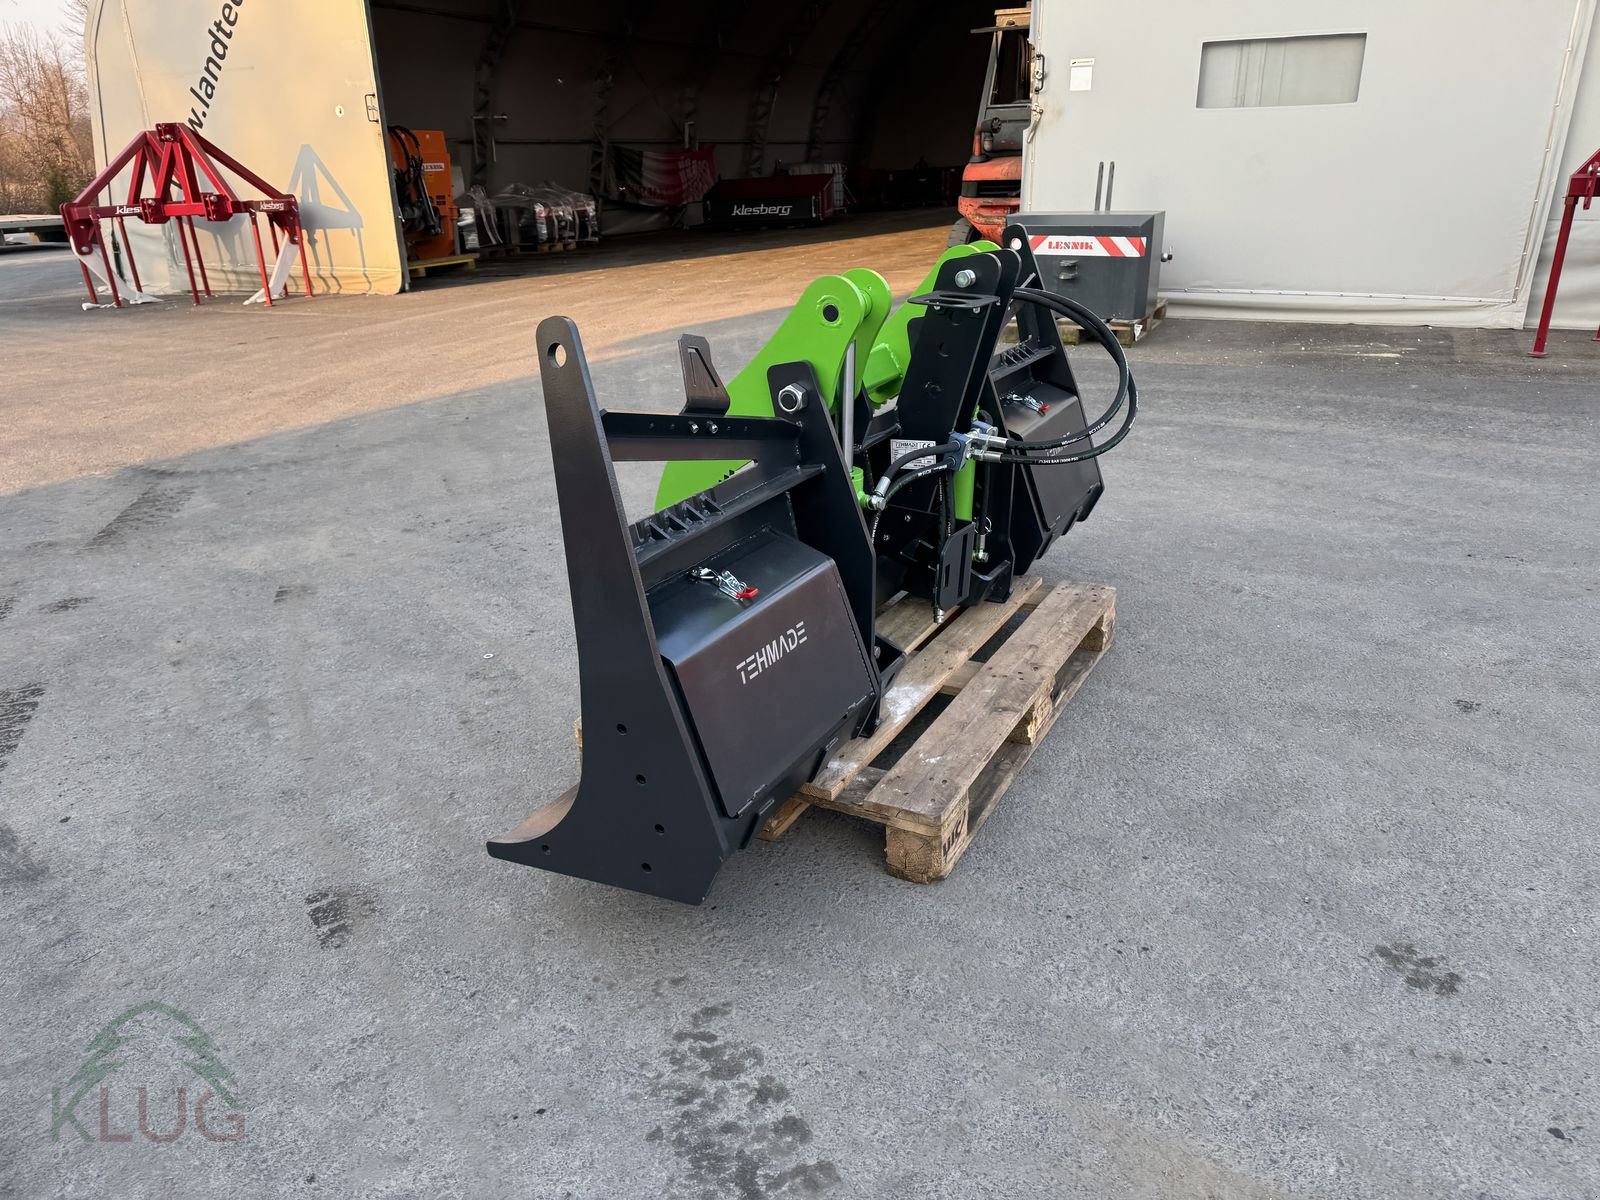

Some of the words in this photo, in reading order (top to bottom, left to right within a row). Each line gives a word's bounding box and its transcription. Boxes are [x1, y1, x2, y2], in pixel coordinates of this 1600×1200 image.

[731, 203, 793, 216] klesberg
[1048, 241, 1093, 250] LESNIK
[736, 621, 807, 685] TEHMADE
